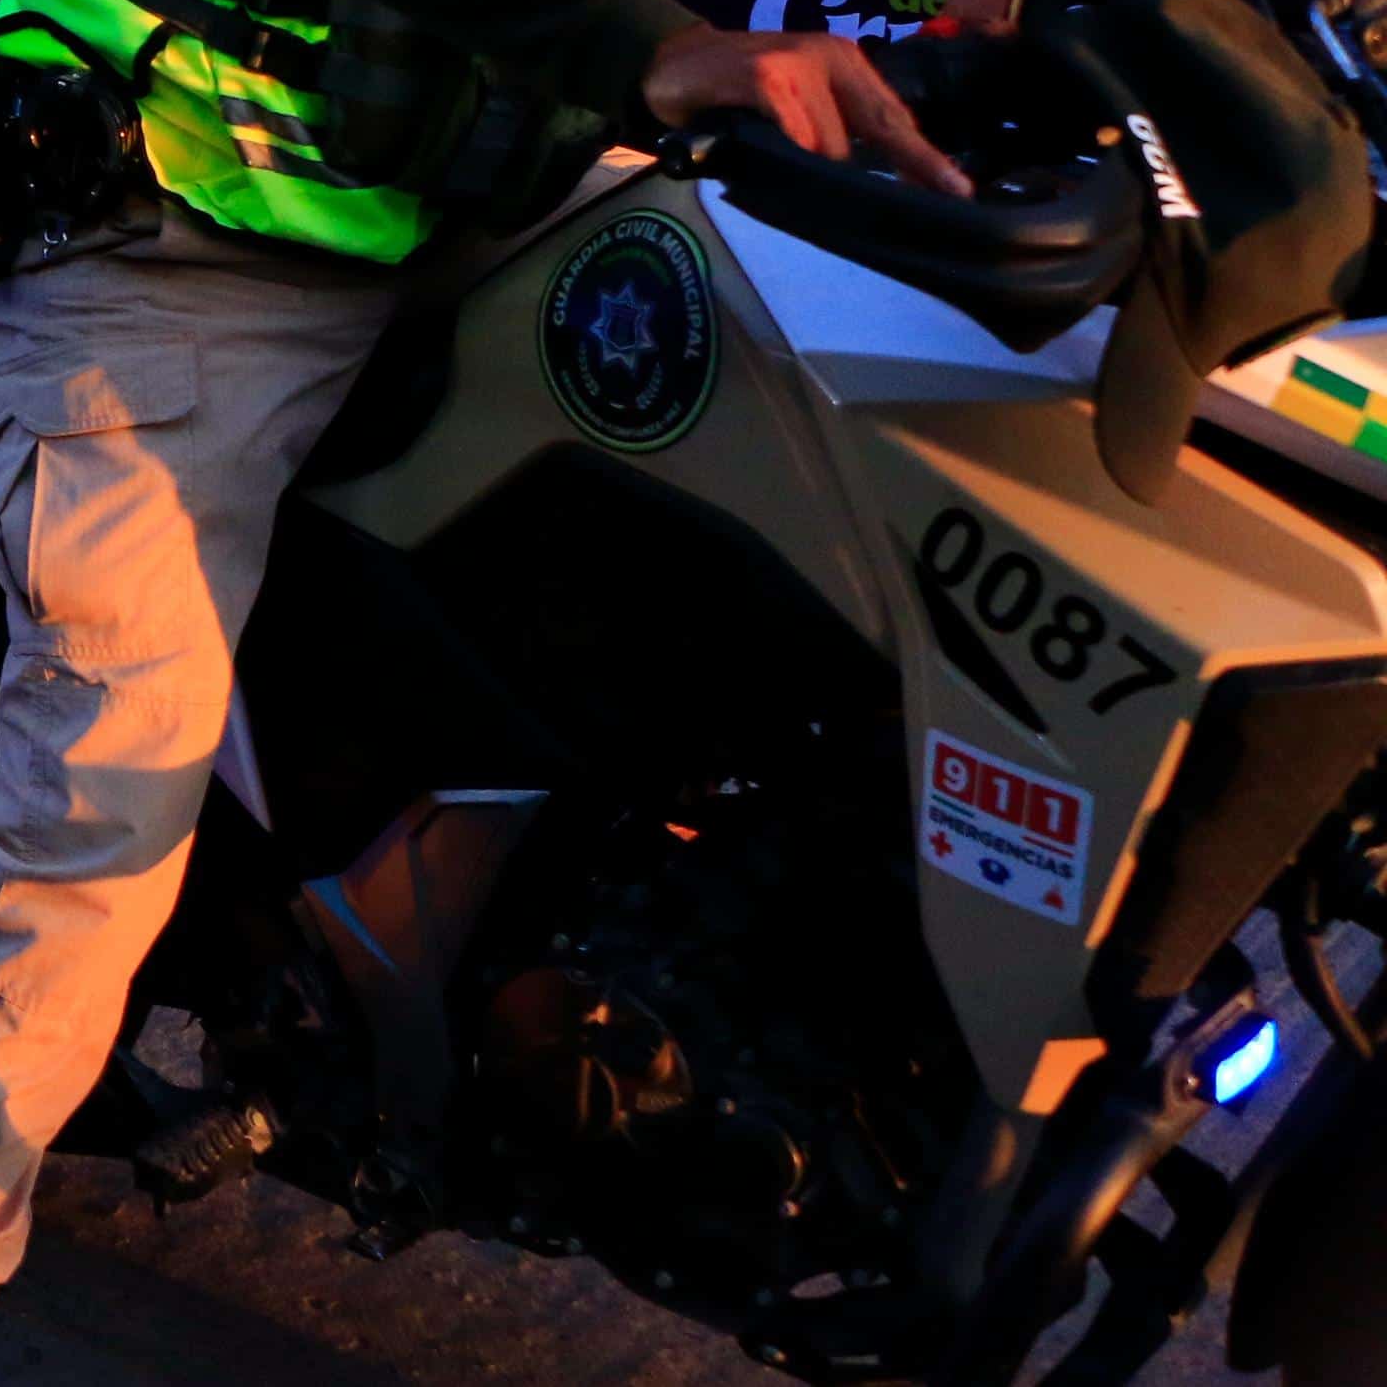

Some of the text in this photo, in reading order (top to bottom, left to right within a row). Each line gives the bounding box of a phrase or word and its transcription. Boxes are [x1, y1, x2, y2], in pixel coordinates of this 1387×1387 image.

[551, 230, 613, 327] GUARDIA
[613, 218, 660, 244] CIVIL
[658, 231, 705, 362] MUNICIPAL
[921, 507, 1177, 716] 0087
[927, 805, 1074, 880] EMERGENCIAS
[937, 751, 1069, 839] 911
